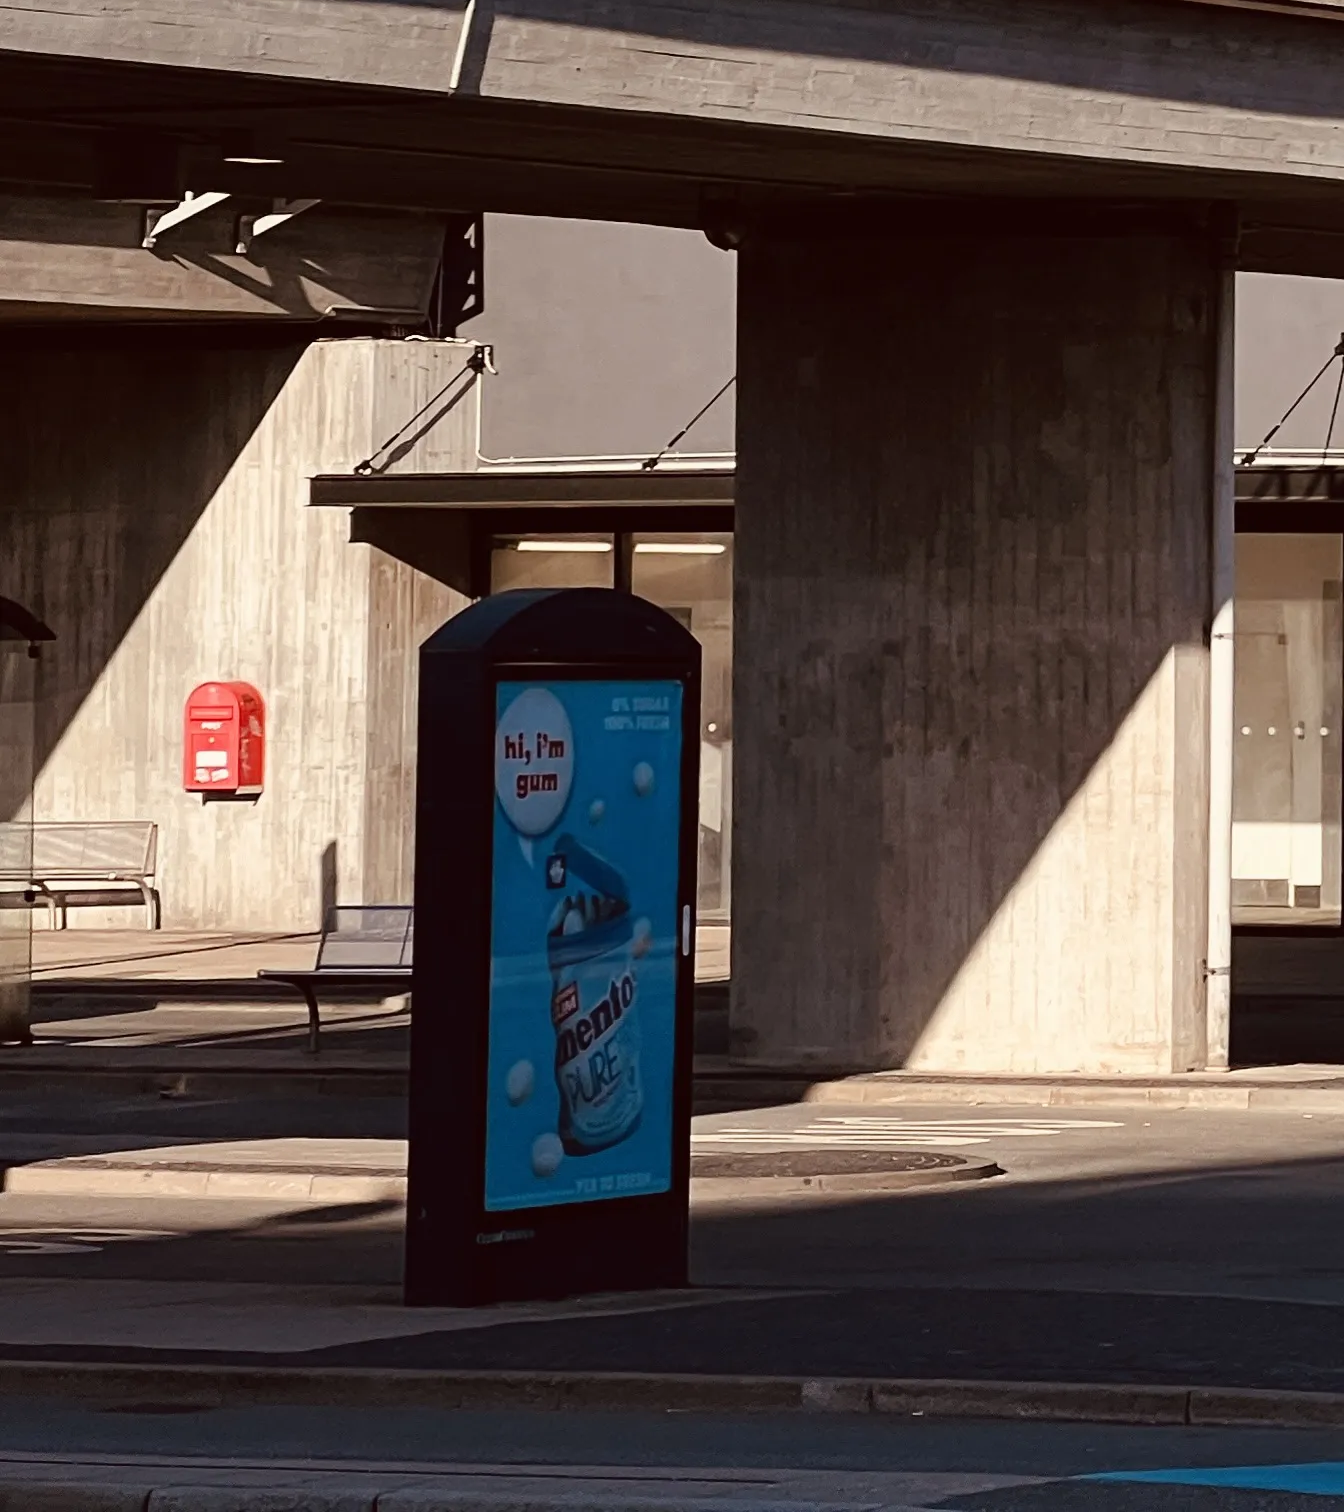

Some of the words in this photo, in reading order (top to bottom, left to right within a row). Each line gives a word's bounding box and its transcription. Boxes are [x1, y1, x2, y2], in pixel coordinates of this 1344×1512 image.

[505, 732, 531, 765] hi,
[516, 773, 558, 799] gum
[565, 1037, 622, 1114] PURE
